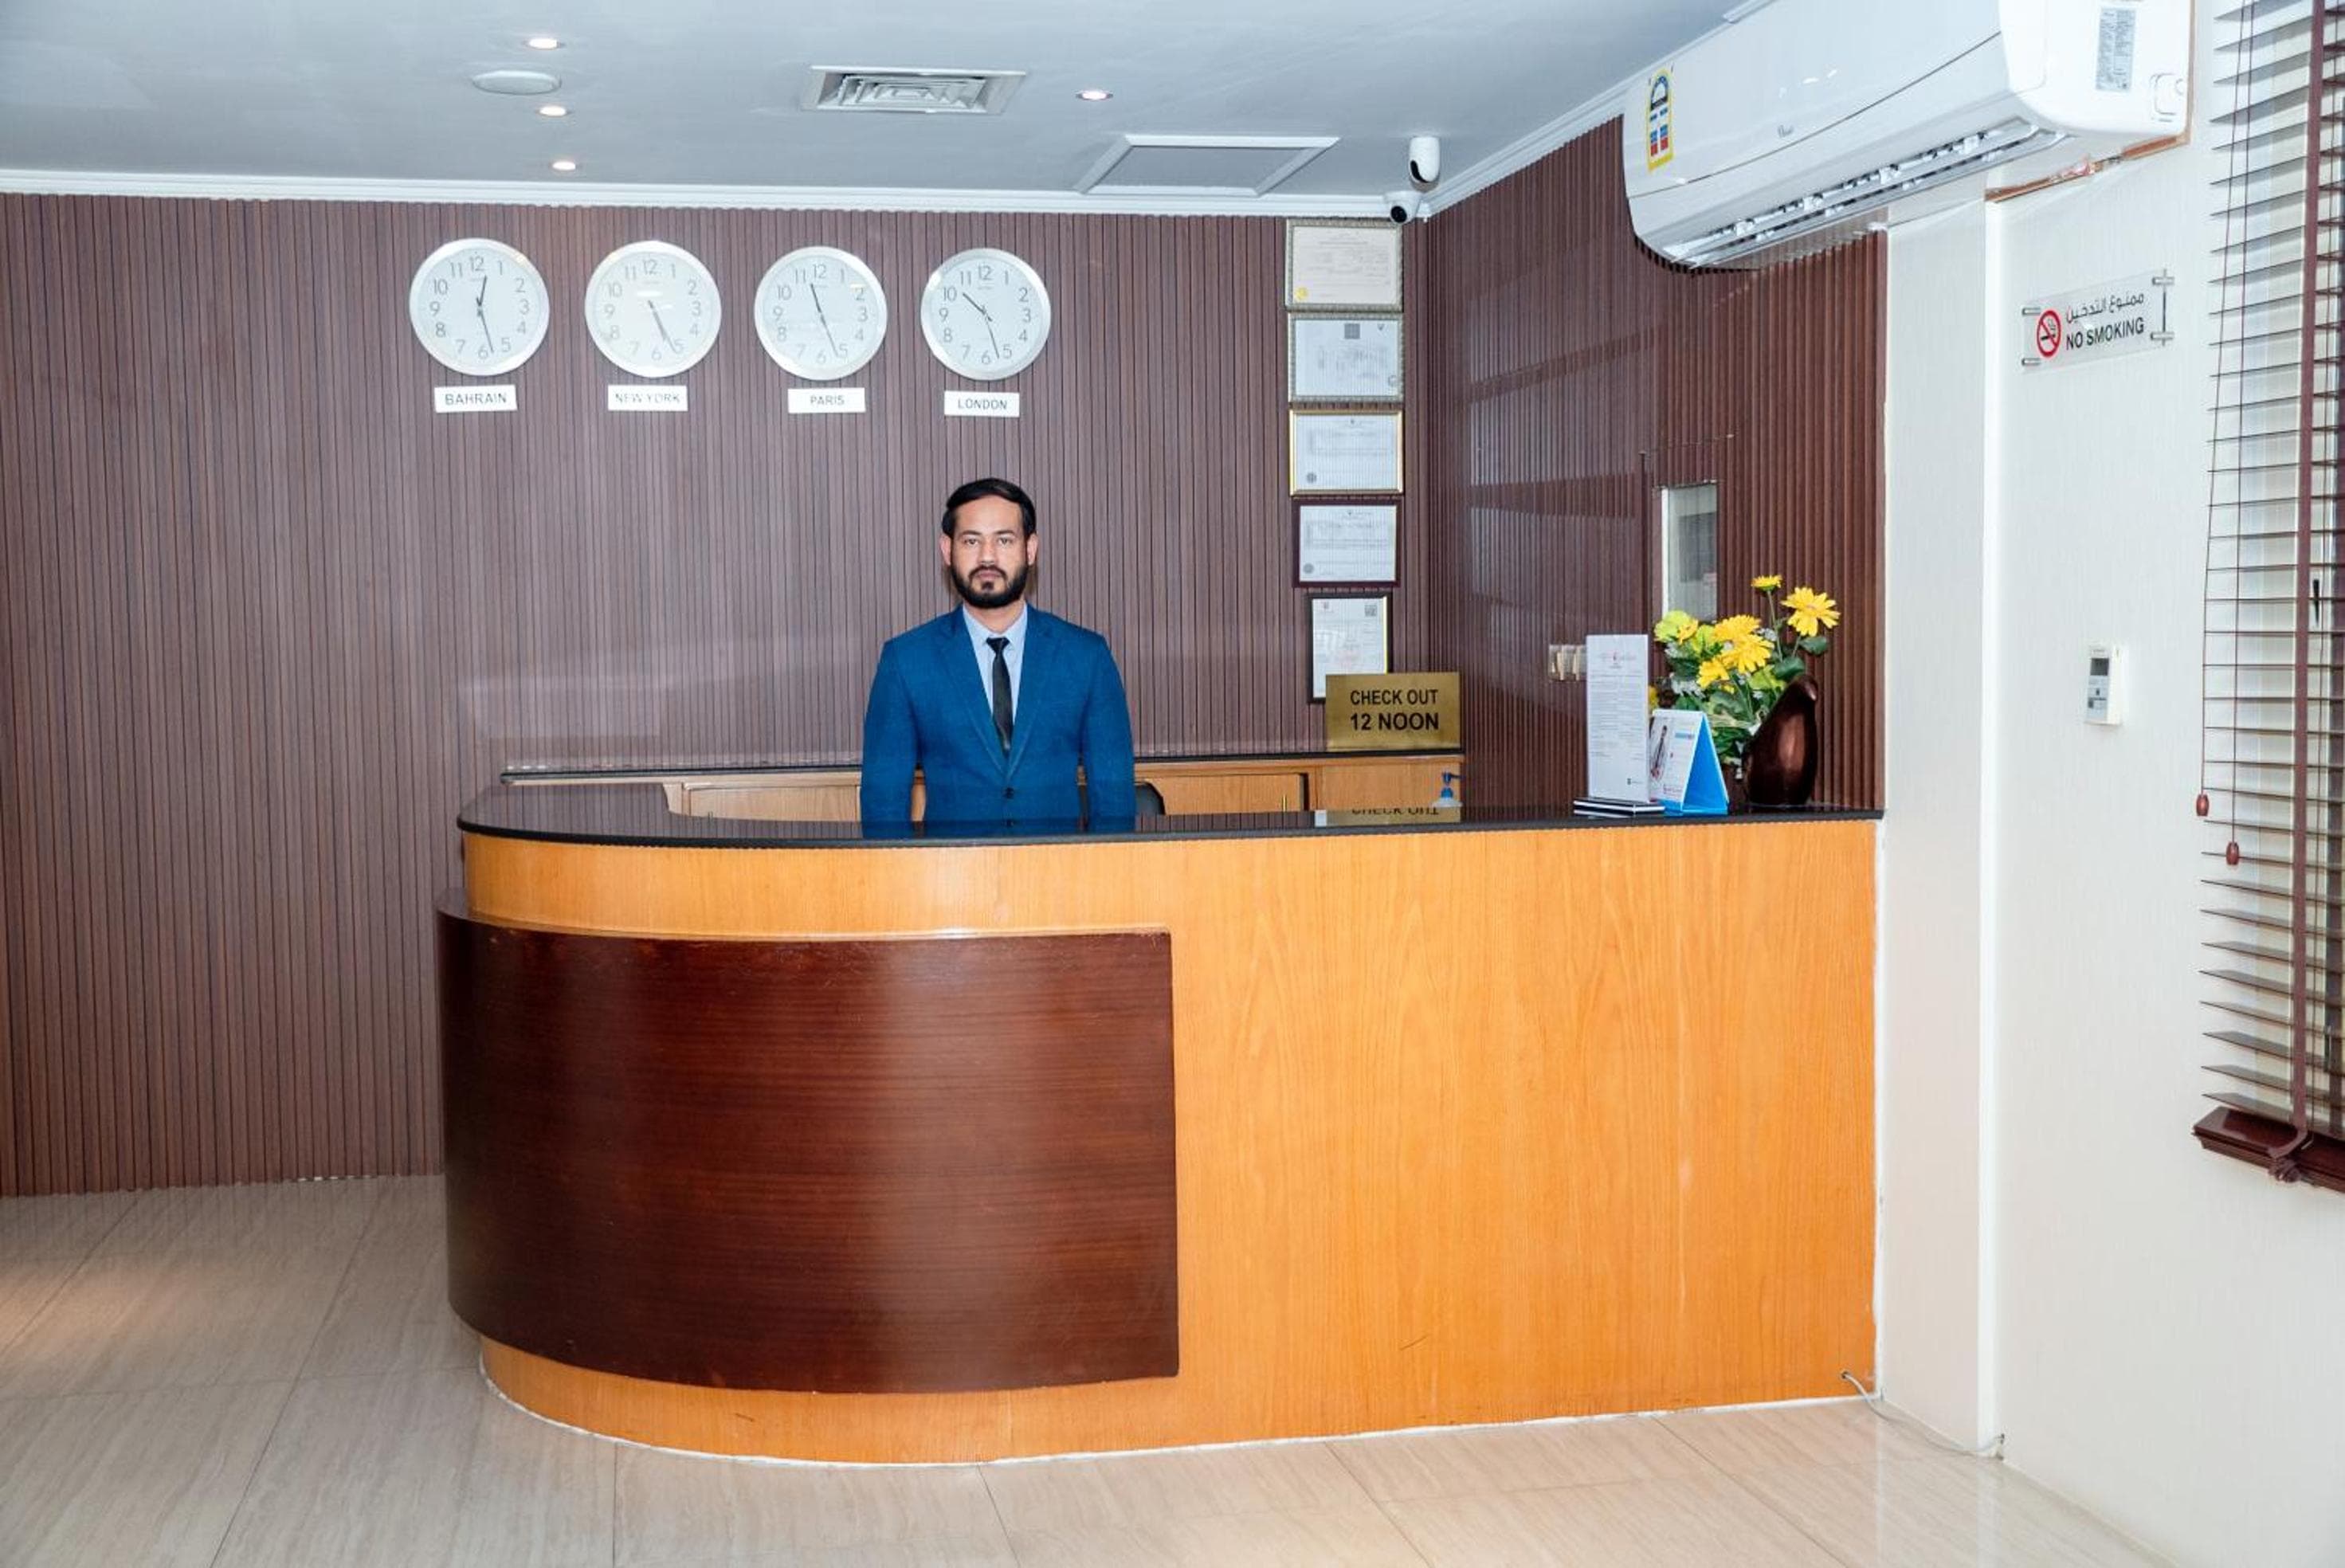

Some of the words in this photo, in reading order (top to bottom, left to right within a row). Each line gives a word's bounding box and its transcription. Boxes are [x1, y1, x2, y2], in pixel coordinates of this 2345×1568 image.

[450, 262, 463, 277] 11
[469, 256, 484, 272] 12
[499, 261, 503, 275] 1
[644, 259, 657, 275] 12
[671, 264, 676, 278] 1
[625, 266, 636, 280] 11
[796, 269, 806, 283] 11
[813, 264, 826, 279] 12
[841, 269, 845, 283] 1
[960, 271, 971, 285] 11
[978, 265, 992, 280] 12
[1005, 271, 1008, 284] 1
[434, 279, 448, 295] 10
[516, 278, 525, 292] 2
[610, 282, 622, 297] 10
[688, 280, 698, 295] 2
[778, 285, 791, 300] 10
[856, 288, 865, 300] 2
[943, 288, 956, 301] 10
[1019, 288, 1029, 302] 2
[429, 302, 440, 316] 9
[520, 300, 529, 315] 3
[692, 301, 700, 316] 3
[2110, 291, 2144, 313] ممنوع
[605, 304, 615, 318] 9
[774, 307, 782, 321] 9
[859, 307, 868, 321] 3
[939, 308, 948, 321] 9
[1022, 308, 1031, 323] 3
[2066, 298, 2108, 323] التدخين
[436, 322, 445, 338] 8
[516, 321, 526, 334] 4
[610, 325, 620, 339] 8
[689, 323, 698, 338] 4
[778, 327, 786, 341] 8
[855, 329, 864, 340] 4
[2066, 332, 2084, 351] NO
[2086, 316, 2144, 346] SMOKING
[944, 328, 952, 343] 8
[1018, 330, 1027, 341] 4
[455, 339, 465, 353] 7
[479, 344, 488, 359] 6
[501, 338, 511, 352] 5
[629, 341, 639, 355] 7
[675, 339, 684, 354] 5
[797, 344, 806, 358] 7
[839, 344, 848, 359] 5
[1003, 344, 1012, 359] 5
[652, 347, 661, 360] 6
[817, 351, 826, 364] 6
[963, 346, 971, 359] 7
[982, 351, 990, 365] 6
[445, 392, 507, 406] BAHRAIN
[615, 393, 643, 404] NEW
[646, 393, 680, 404] YORK
[810, 394, 845, 406] PARIS
[958, 399, 1008, 410] LONDON
[1351, 689, 1402, 706] CHECK
[1407, 689, 1439, 705] OUT
[1350, 712, 1371, 731] 12
[1378, 711, 1439, 731] NOON
